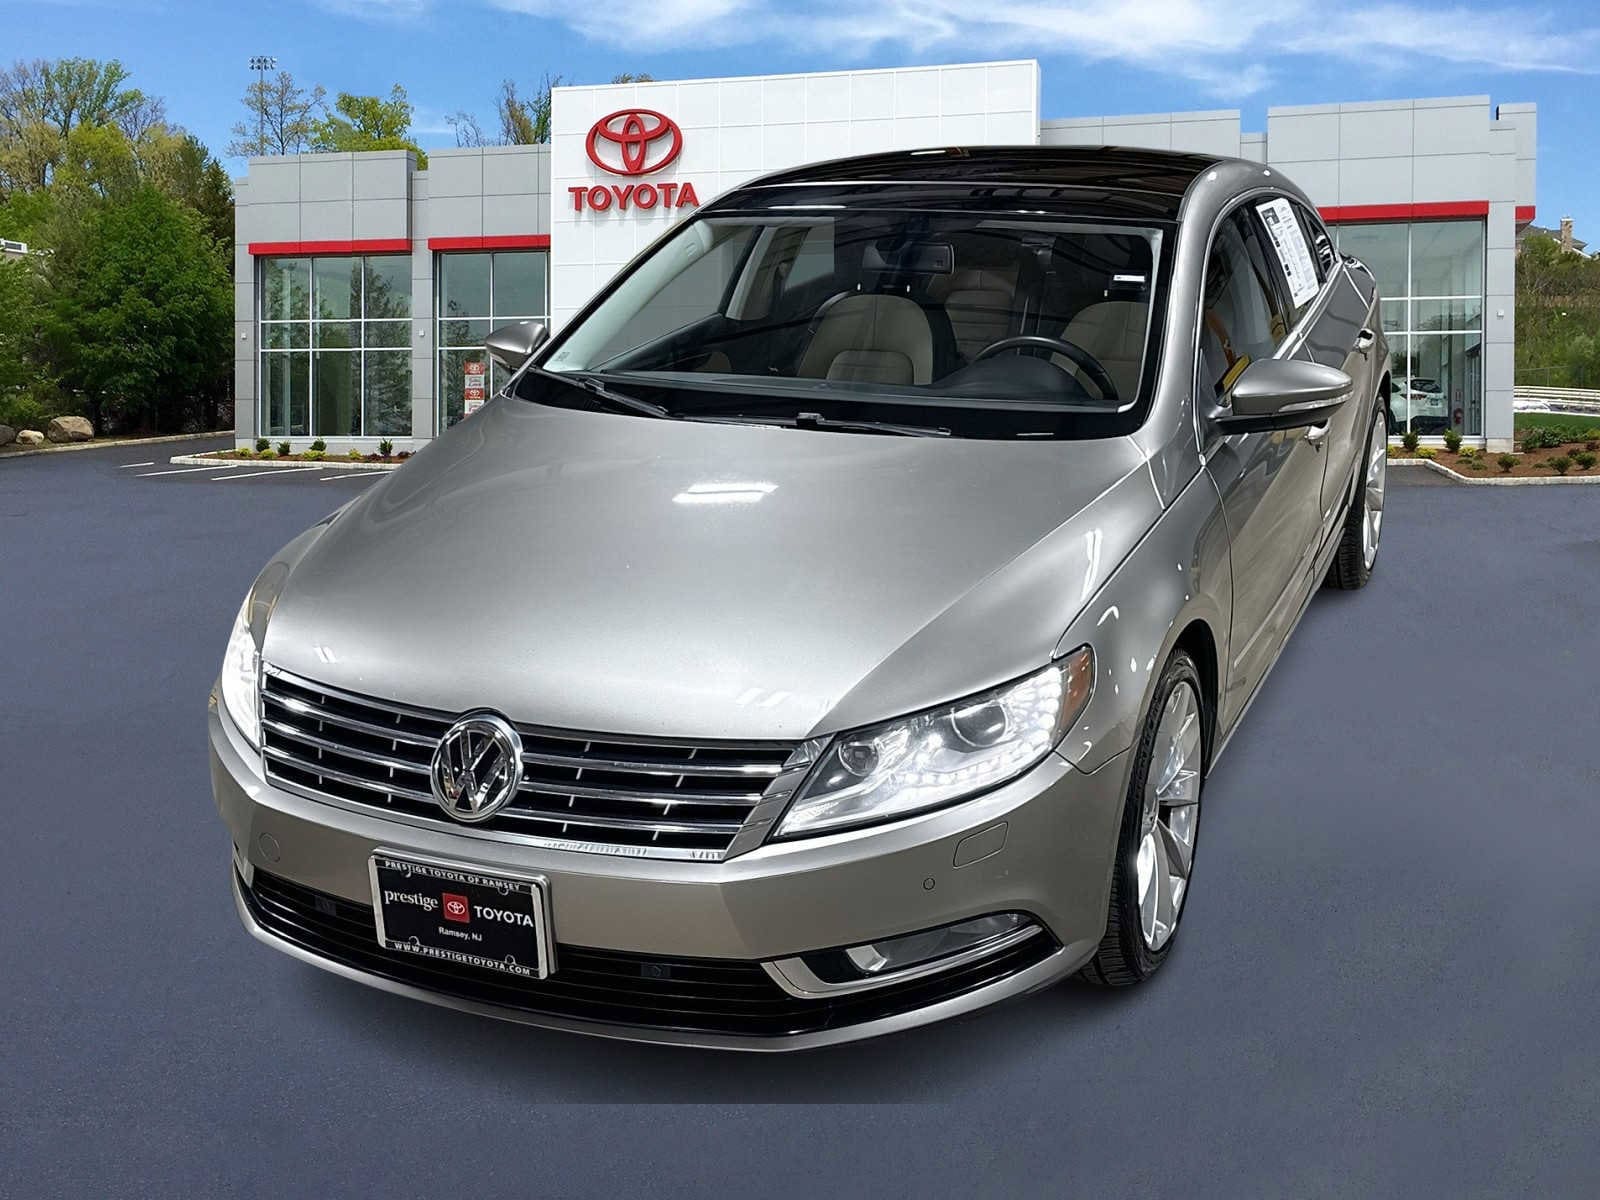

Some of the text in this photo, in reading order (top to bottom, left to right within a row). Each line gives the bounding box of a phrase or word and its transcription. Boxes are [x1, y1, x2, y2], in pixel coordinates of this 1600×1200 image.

[568, 182, 700, 211] TOYOTA
[384, 860, 520, 891] PRESTIGE TOYOTA OF RAMSEY
[384, 890, 439, 911] prestige
[473, 905, 534, 927] TOYOTA
[438, 926, 483, 941] Ramsey, NJ
[393, 942, 531, 976] WWW.PRESTIGETOYOTA.COM
